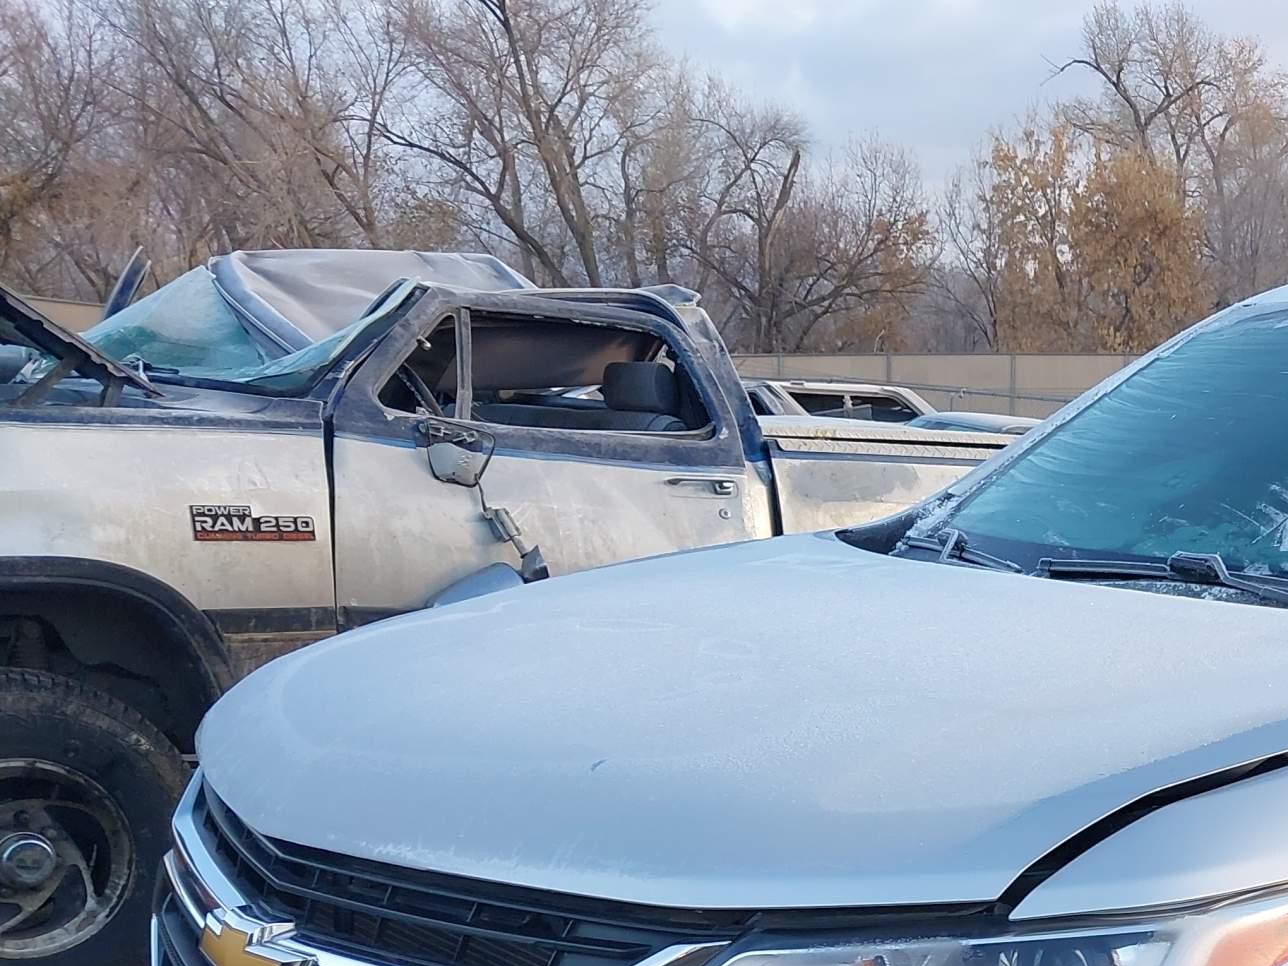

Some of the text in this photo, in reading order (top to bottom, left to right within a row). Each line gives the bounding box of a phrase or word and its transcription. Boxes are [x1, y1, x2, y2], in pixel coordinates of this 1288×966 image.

[192, 505, 251, 515] POWER
[194, 516, 314, 532] RAM 250
